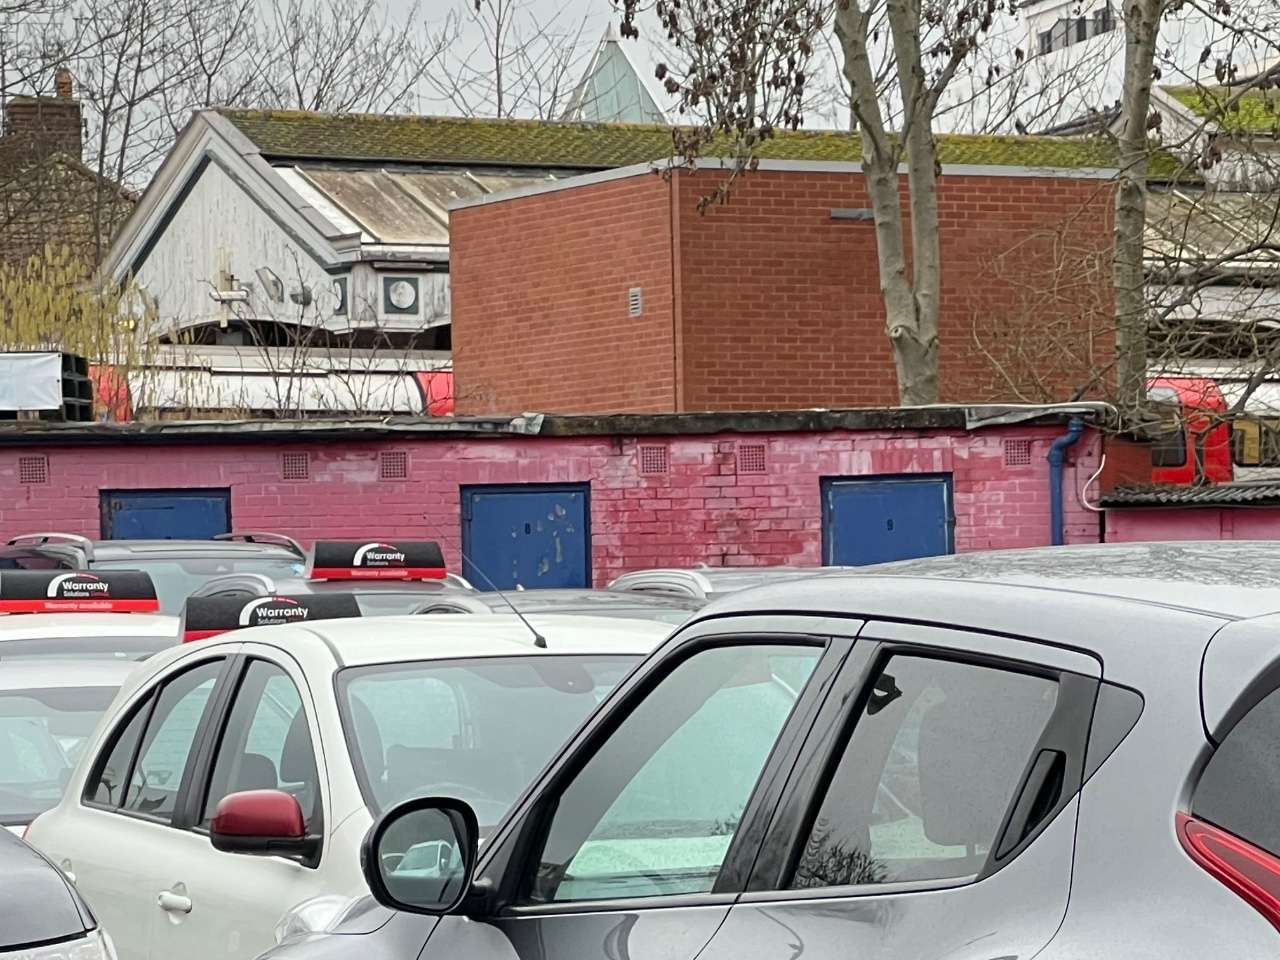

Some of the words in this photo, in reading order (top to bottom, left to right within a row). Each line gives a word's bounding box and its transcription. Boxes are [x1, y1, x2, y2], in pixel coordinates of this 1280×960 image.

[366, 552, 405, 562] Warranty
[62, 581, 109, 593] Warranty
[256, 607, 309, 618] Warranty
